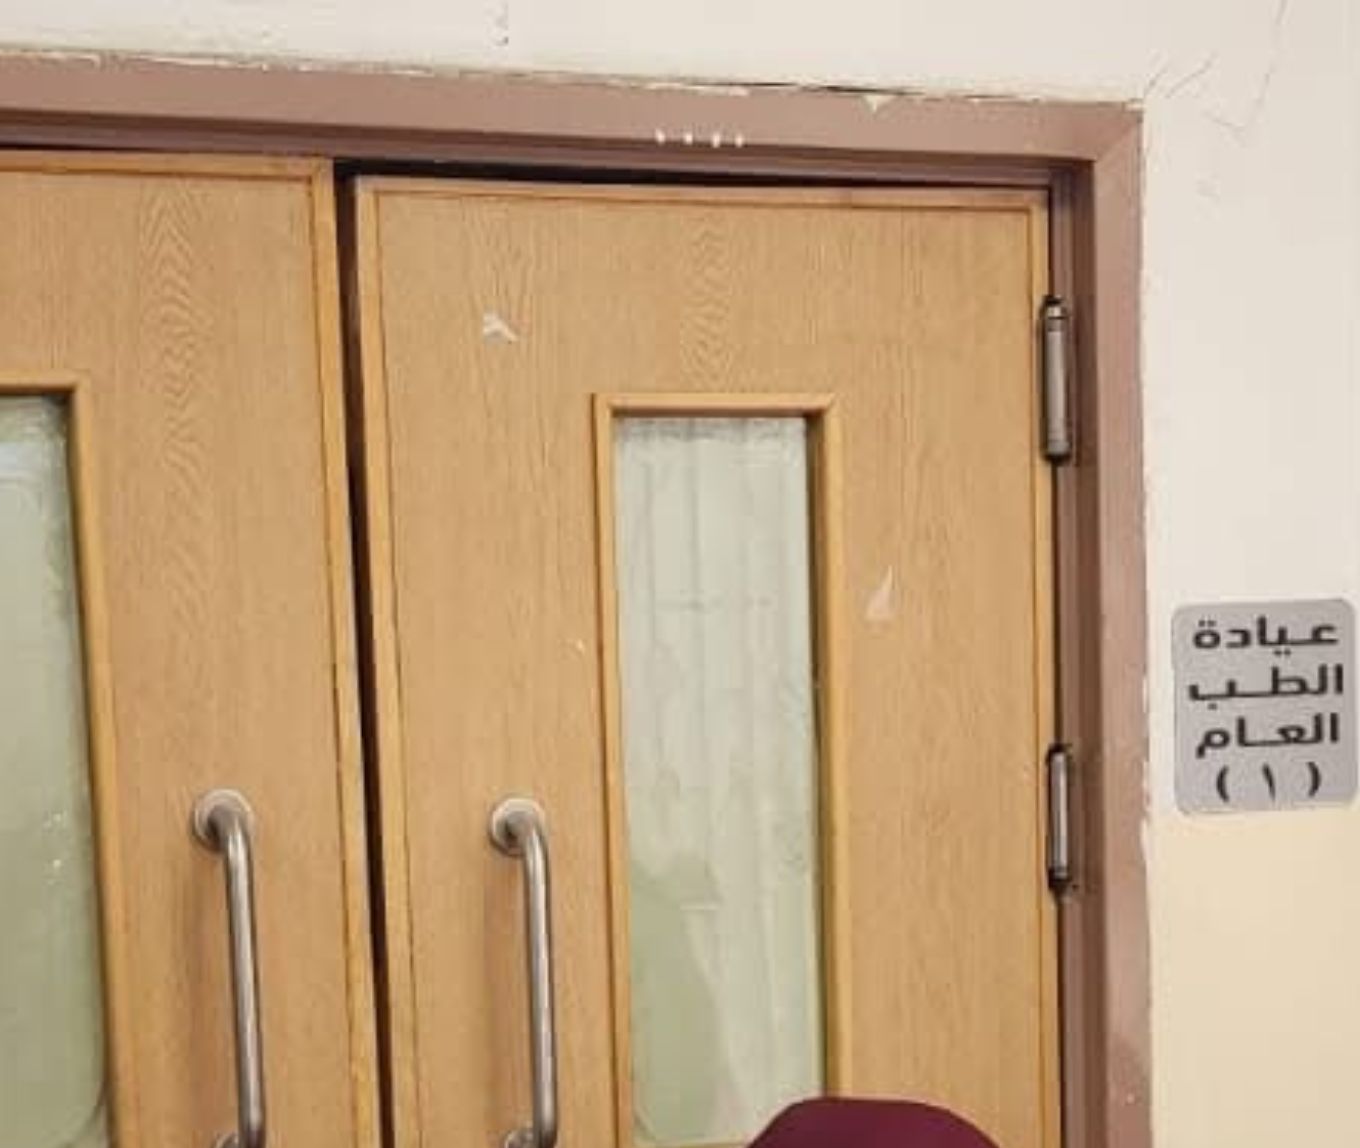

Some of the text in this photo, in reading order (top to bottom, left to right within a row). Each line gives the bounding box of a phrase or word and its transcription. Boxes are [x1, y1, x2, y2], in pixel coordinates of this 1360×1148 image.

[1193, 616, 1339, 656] عيادة
[1188, 662, 1344, 711] الطب
[1195, 712, 1339, 759] العام
